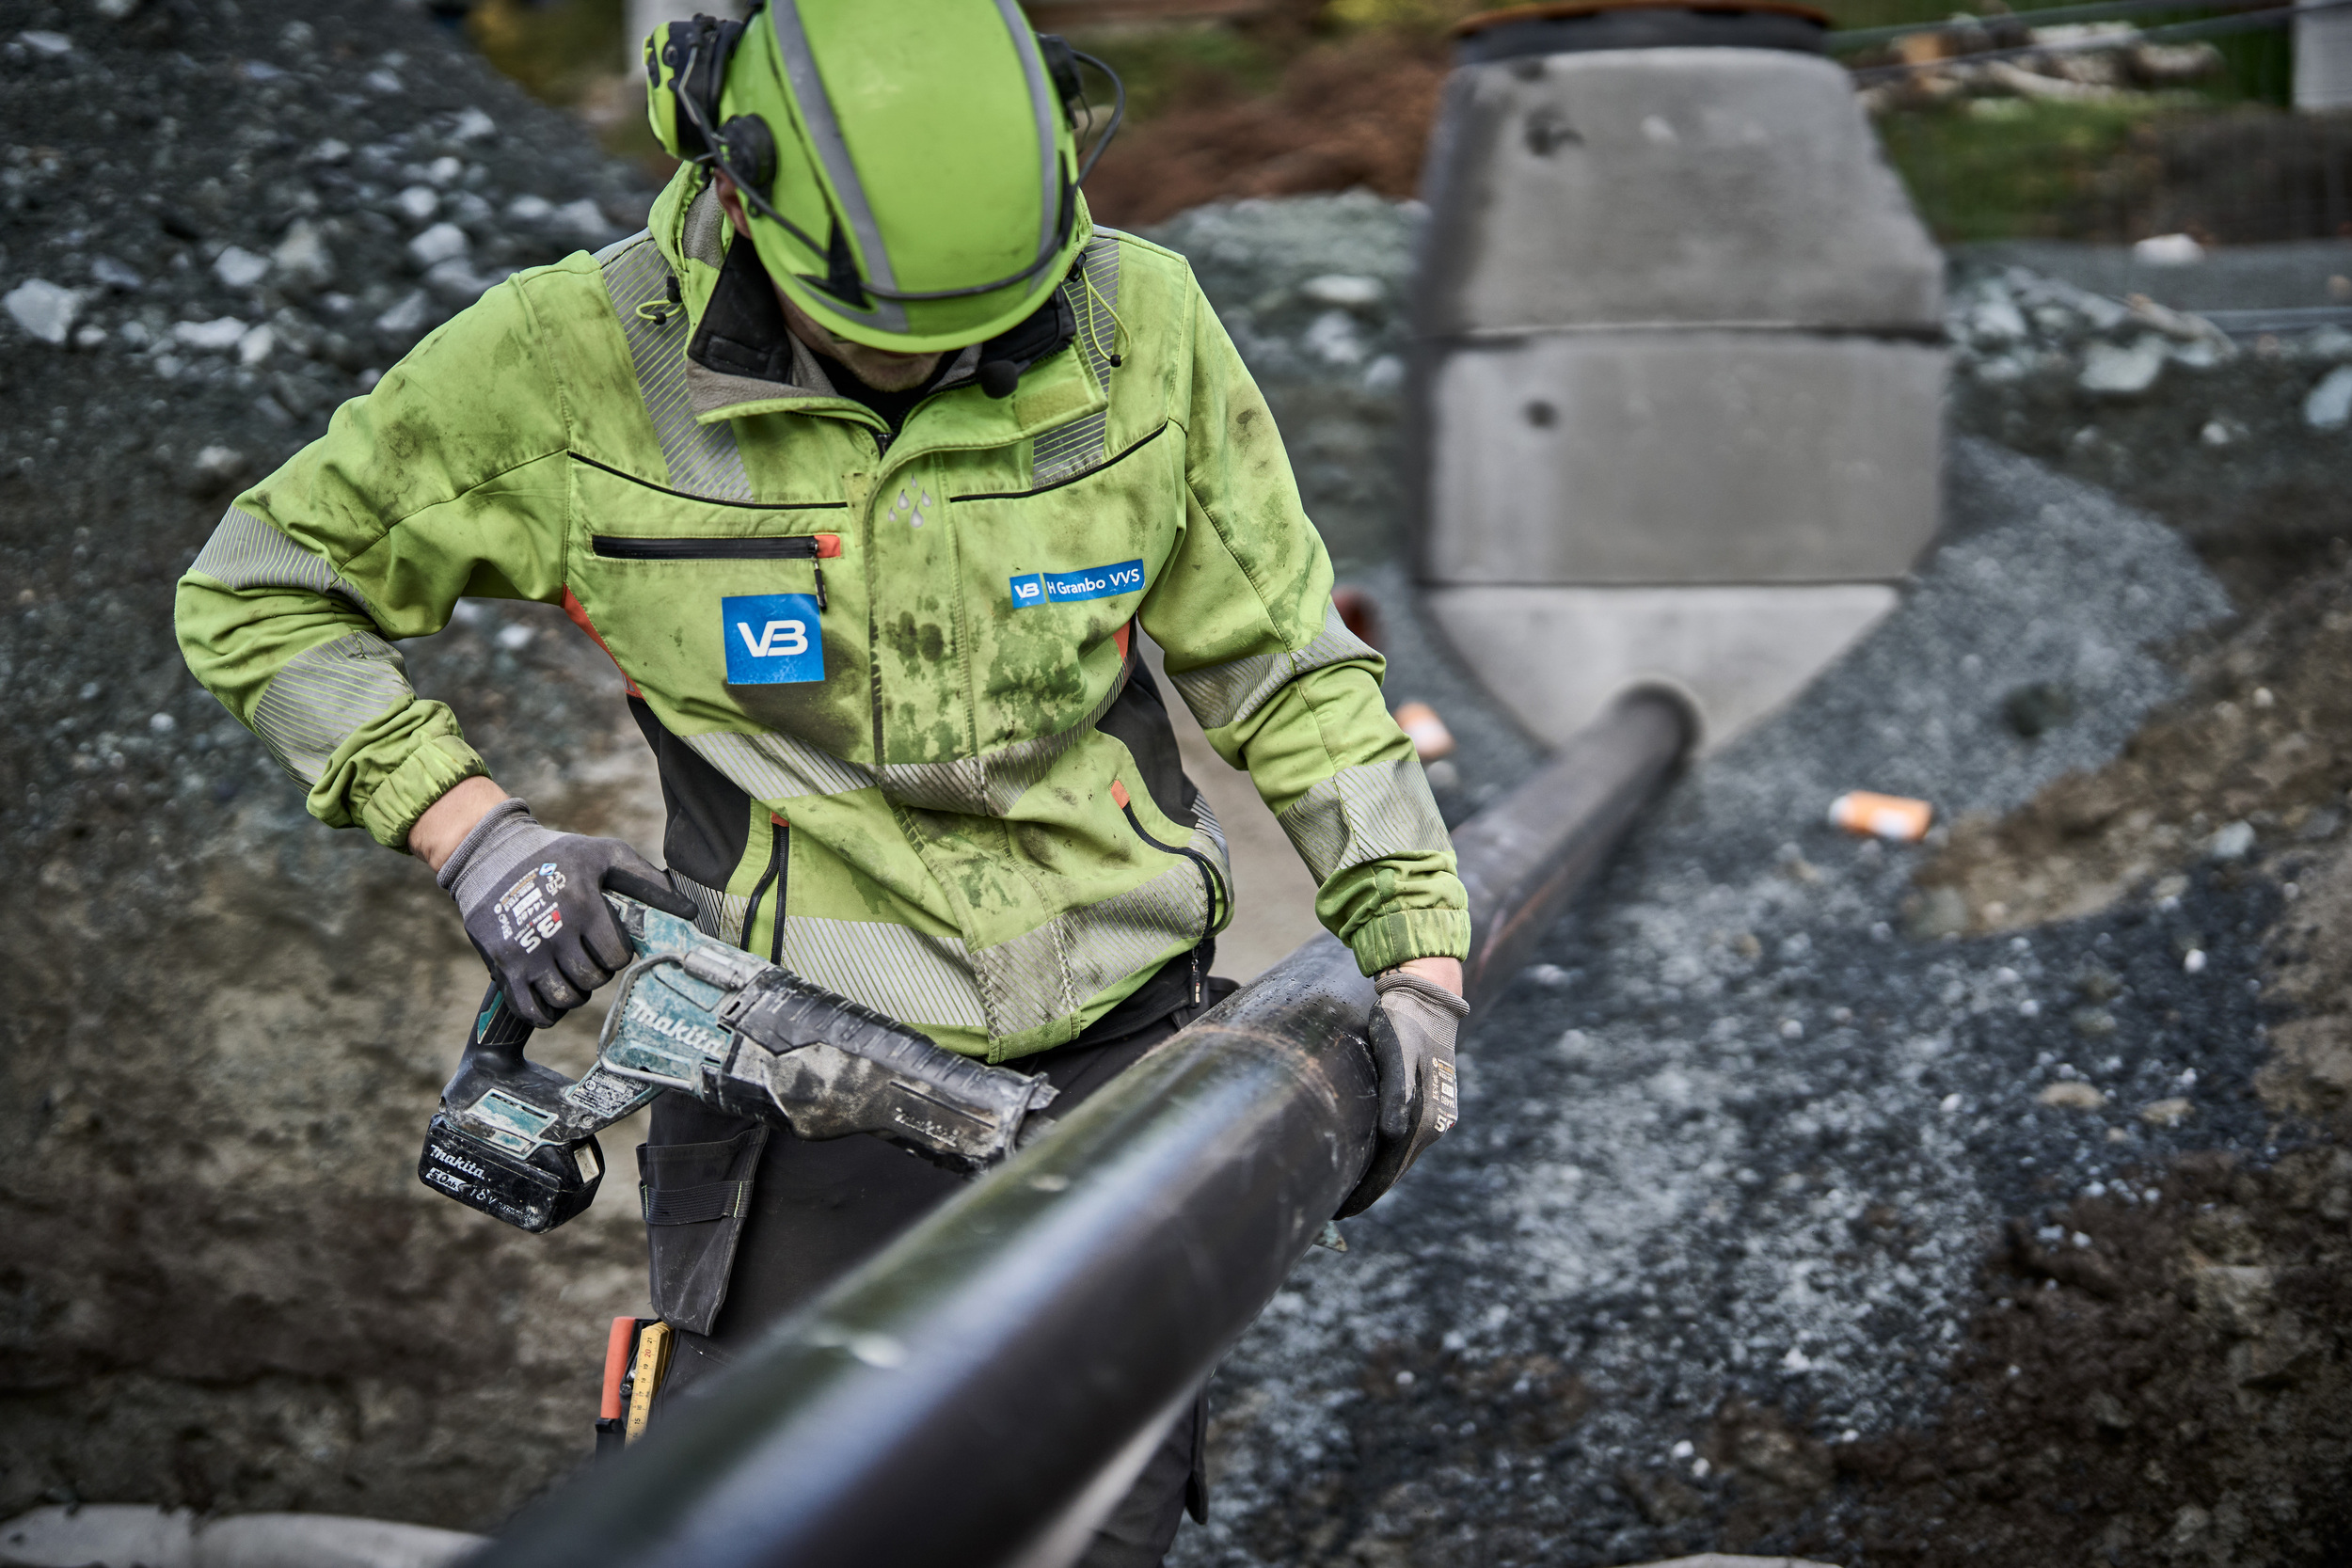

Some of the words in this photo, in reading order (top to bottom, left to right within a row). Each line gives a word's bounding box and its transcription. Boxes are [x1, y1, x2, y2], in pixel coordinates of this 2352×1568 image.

[1014, 582, 1040, 598] VB
[1046, 580, 1057, 594] H
[1057, 578, 1106, 594] Granbo
[1109, 568, 1140, 587] VVS
[737, 619, 809, 657] VB
[629, 997, 725, 1060] makita
[430, 1144, 485, 1180] makita
[644, 1349, 652, 1358] 20
